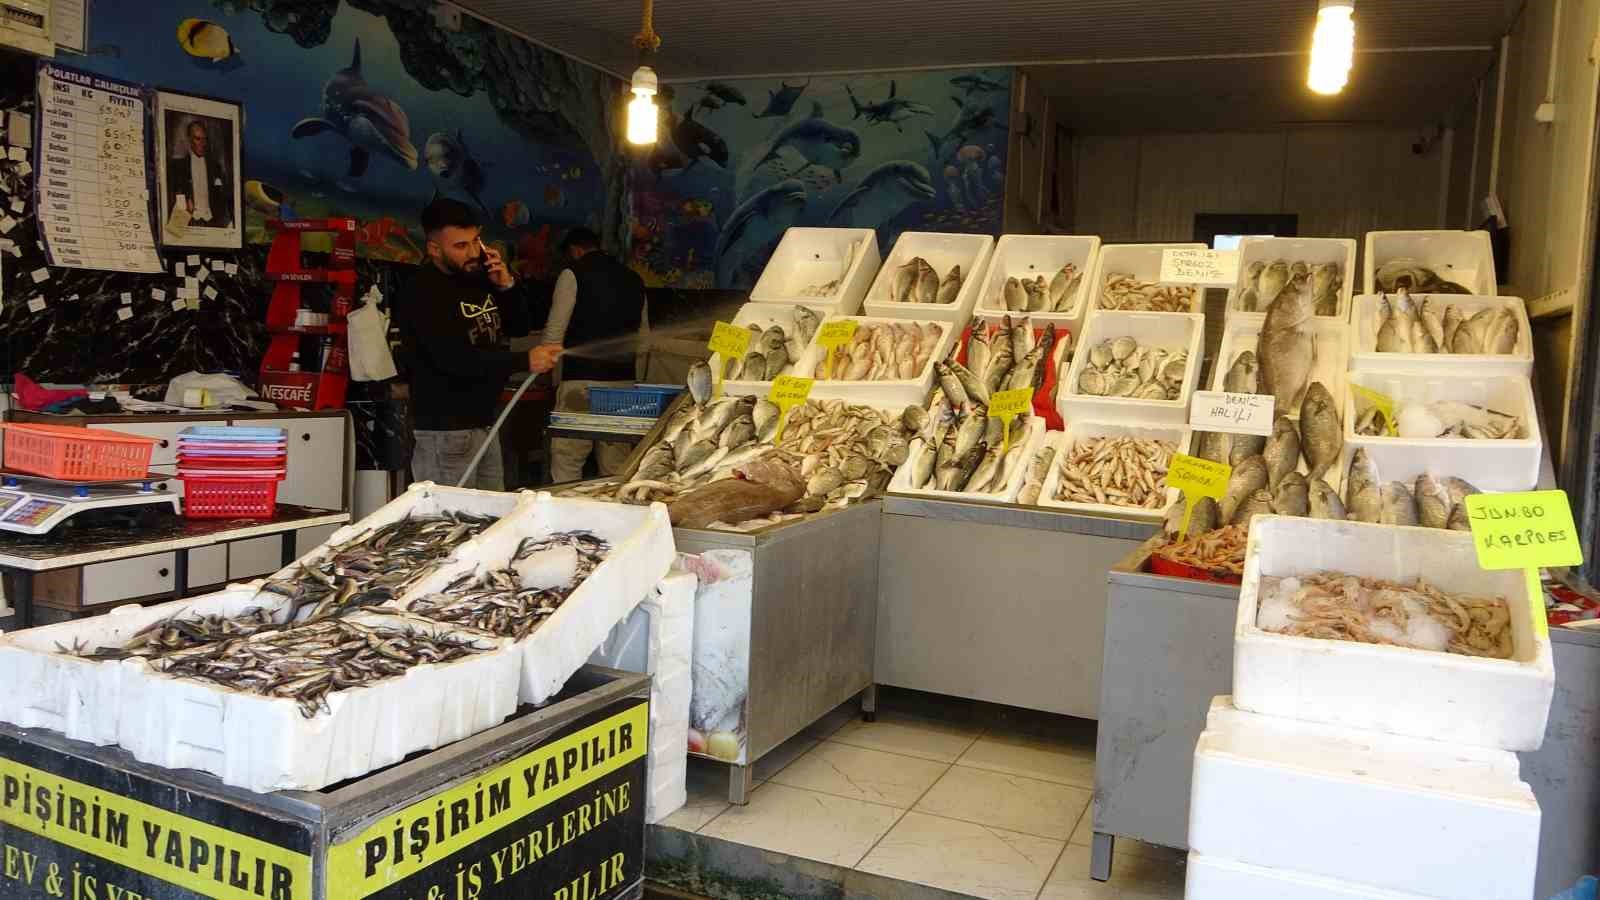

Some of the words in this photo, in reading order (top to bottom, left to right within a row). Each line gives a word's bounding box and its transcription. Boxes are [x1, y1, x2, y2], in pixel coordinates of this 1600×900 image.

[262, 383, 312, 401] NESCAFÉ
[4, 772, 129, 849] PİŞİRİM
[143, 820, 293, 900] YAPILIR
[363, 773, 511, 879] PİŞİRİM
[523, 721, 633, 799] YAPILIR
[490, 781, 632, 885] YERLERİNE
[5, 844, 38, 886] EV
[45, 862, 64, 898] &
